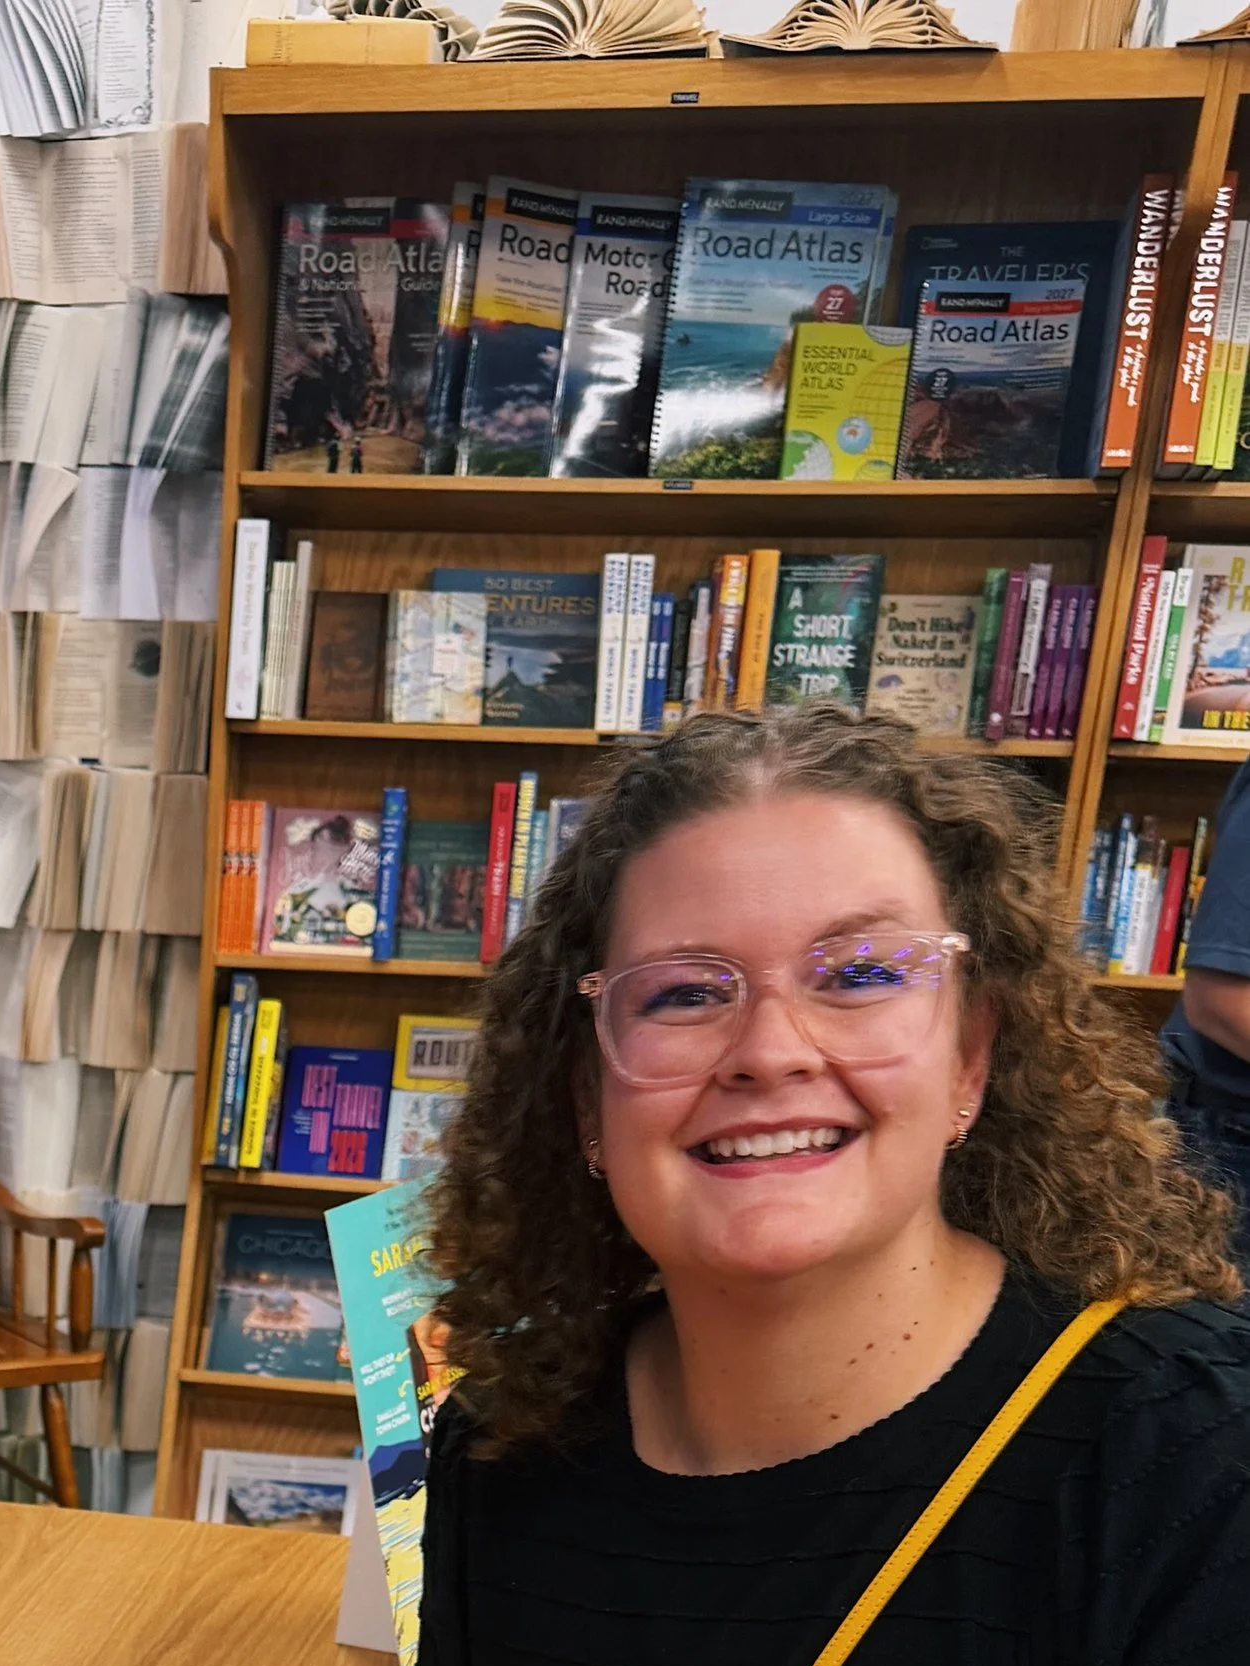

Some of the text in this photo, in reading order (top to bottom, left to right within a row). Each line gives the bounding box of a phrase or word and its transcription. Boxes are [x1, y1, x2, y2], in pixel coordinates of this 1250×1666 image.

[808, 210, 873, 225] Large Scale
[499, 223, 573, 264] Road
[692, 227, 865, 264] Road Atlas
[1000, 246, 1026, 258] THE
[299, 243, 376, 274] Road
[382, 241, 446, 275] Atla
[1125, 188, 1170, 340] WANDERLUST
[1187, 186, 1233, 337] WANDERLUST
[929, 318, 1071, 343] Road Atlas
[802, 345, 876, 362] ESSENTIAL
[801, 362, 858, 377] WORLD
[800, 377, 845, 391] ATLAS
[486, 593, 596, 616] ENTURES
[788, 588, 803, 609] A
[793, 614, 855, 639] SHORT
[887, 616, 926, 632] Don't
[891, 634, 938, 650] Naked
[772, 644, 858, 668] STRANGE
[876, 650, 968, 668] Switzerland
[798, 673, 840, 696] TRIP
